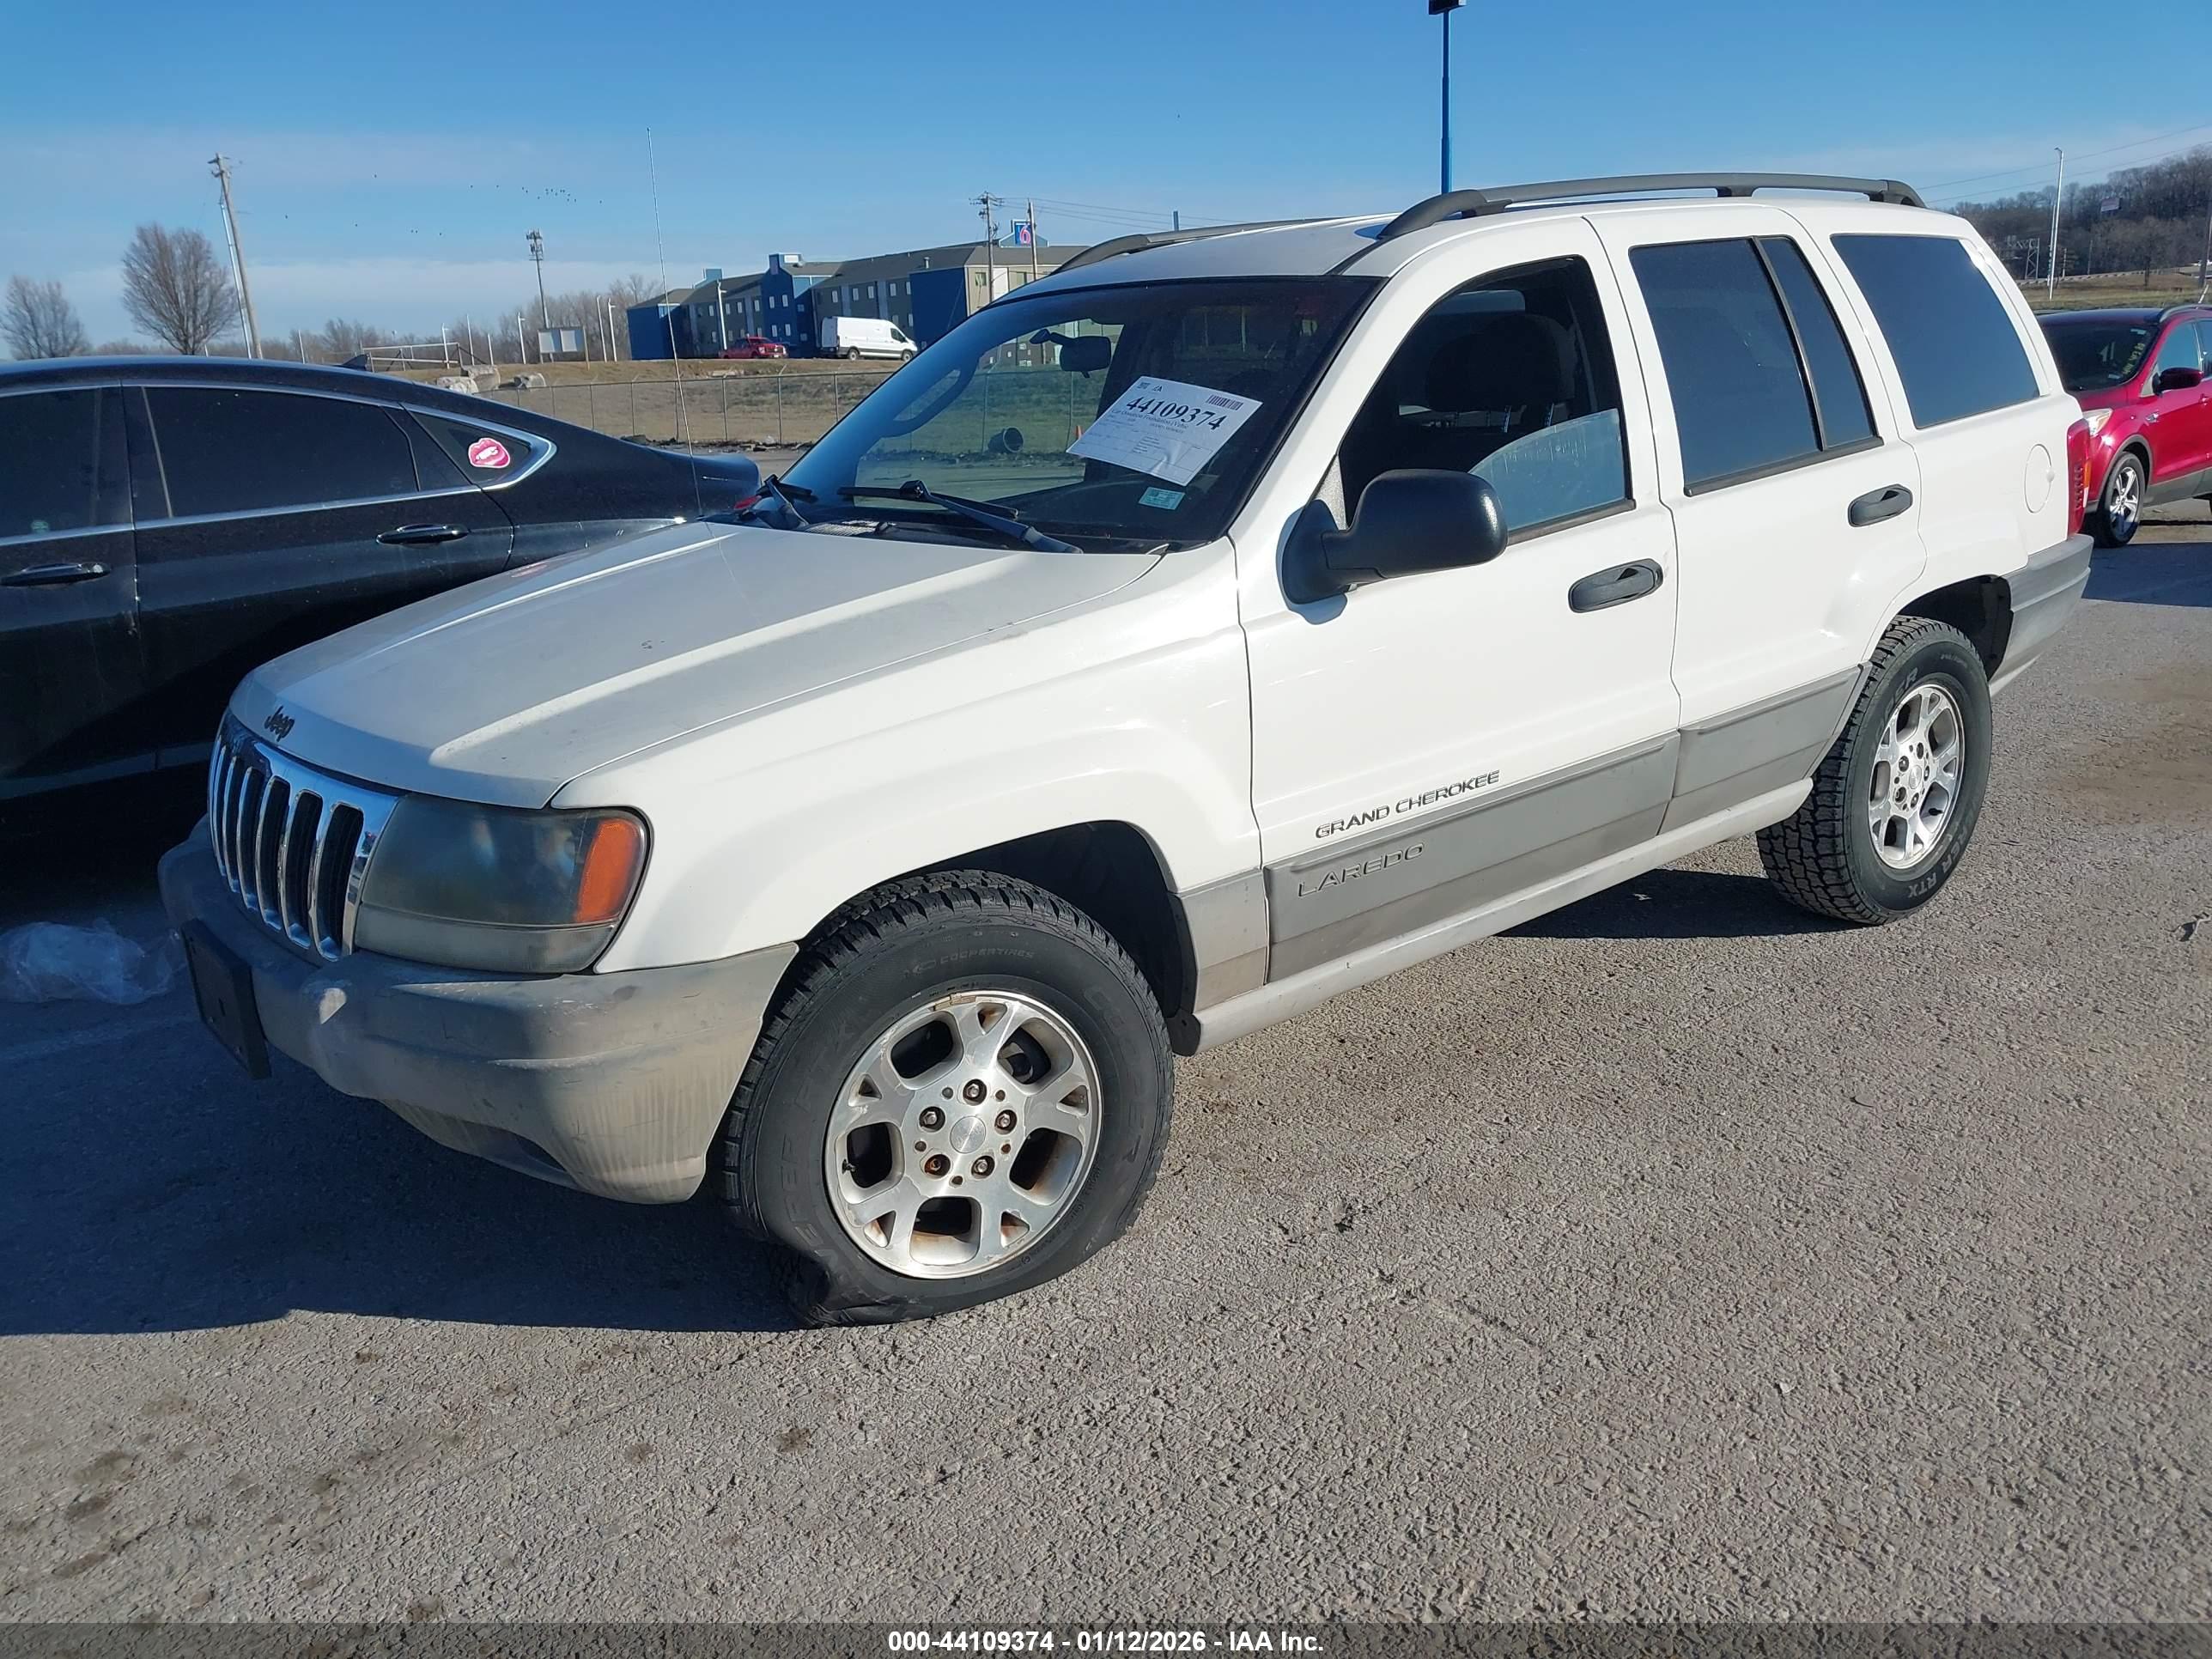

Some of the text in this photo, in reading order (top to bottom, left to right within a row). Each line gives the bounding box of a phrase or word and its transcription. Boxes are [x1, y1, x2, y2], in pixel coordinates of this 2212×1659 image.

[1019, 224, 1031, 246] 6
[1126, 396, 1228, 430] 44109374
[264, 705, 295, 743] Jeep
[1316, 769, 1501, 839] GRAND CHEROKEE
[1297, 842, 1426, 898] LAREDO
[1907, 872, 1937, 898] RTX
